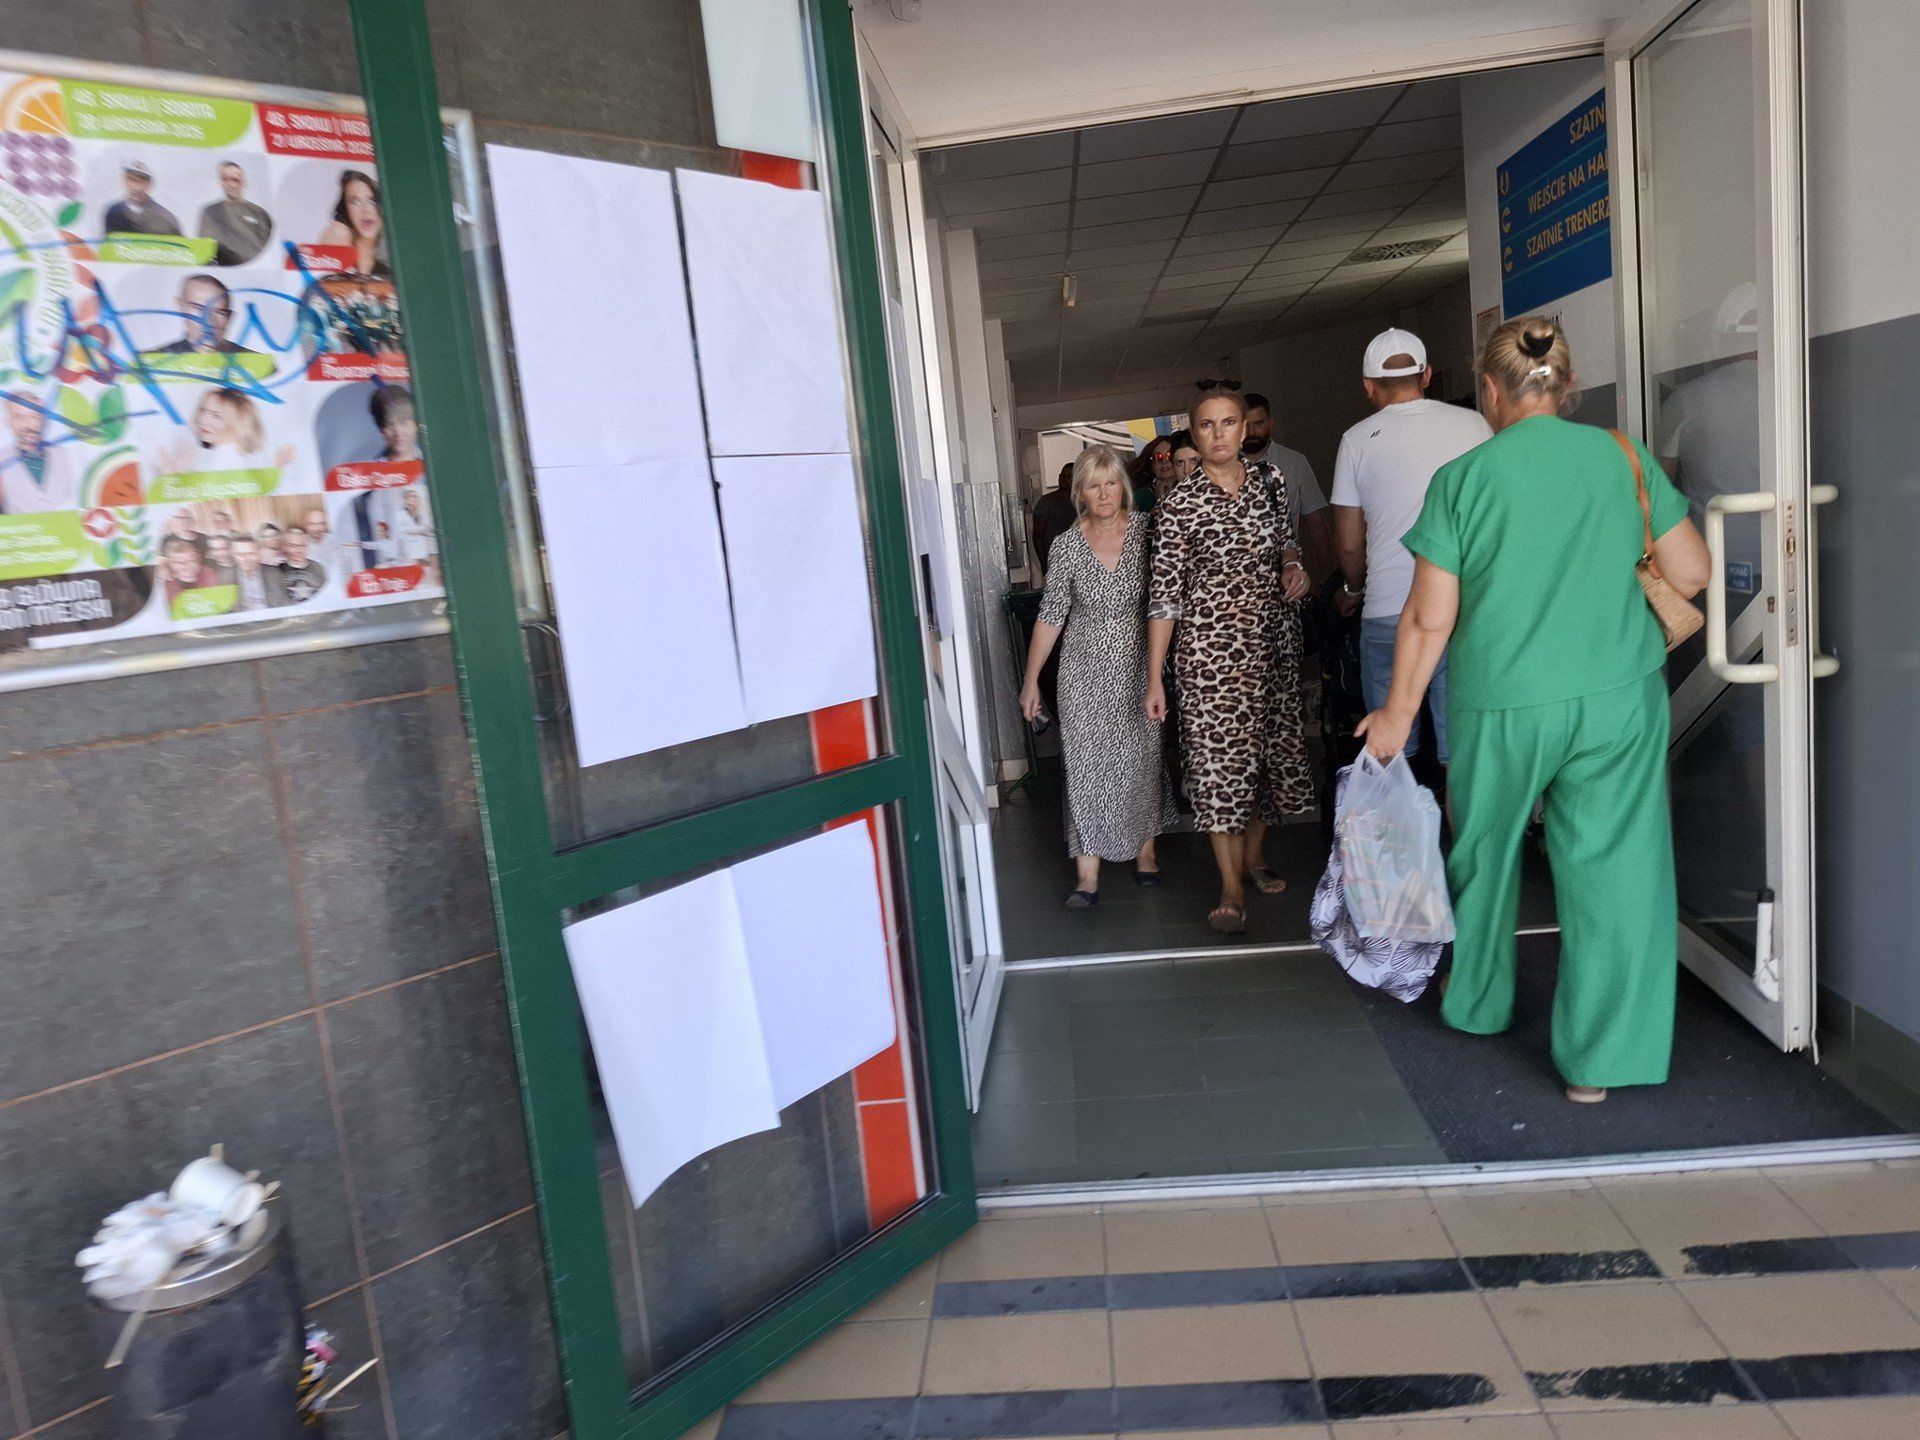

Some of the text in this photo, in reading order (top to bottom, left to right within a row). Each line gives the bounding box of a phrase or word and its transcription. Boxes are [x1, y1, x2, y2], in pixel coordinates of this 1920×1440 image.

[1527, 176, 1566, 215] WEJŚCIE
[1569, 165, 1586, 191] NA
[1526, 223, 1564, 259] SZATNIE
